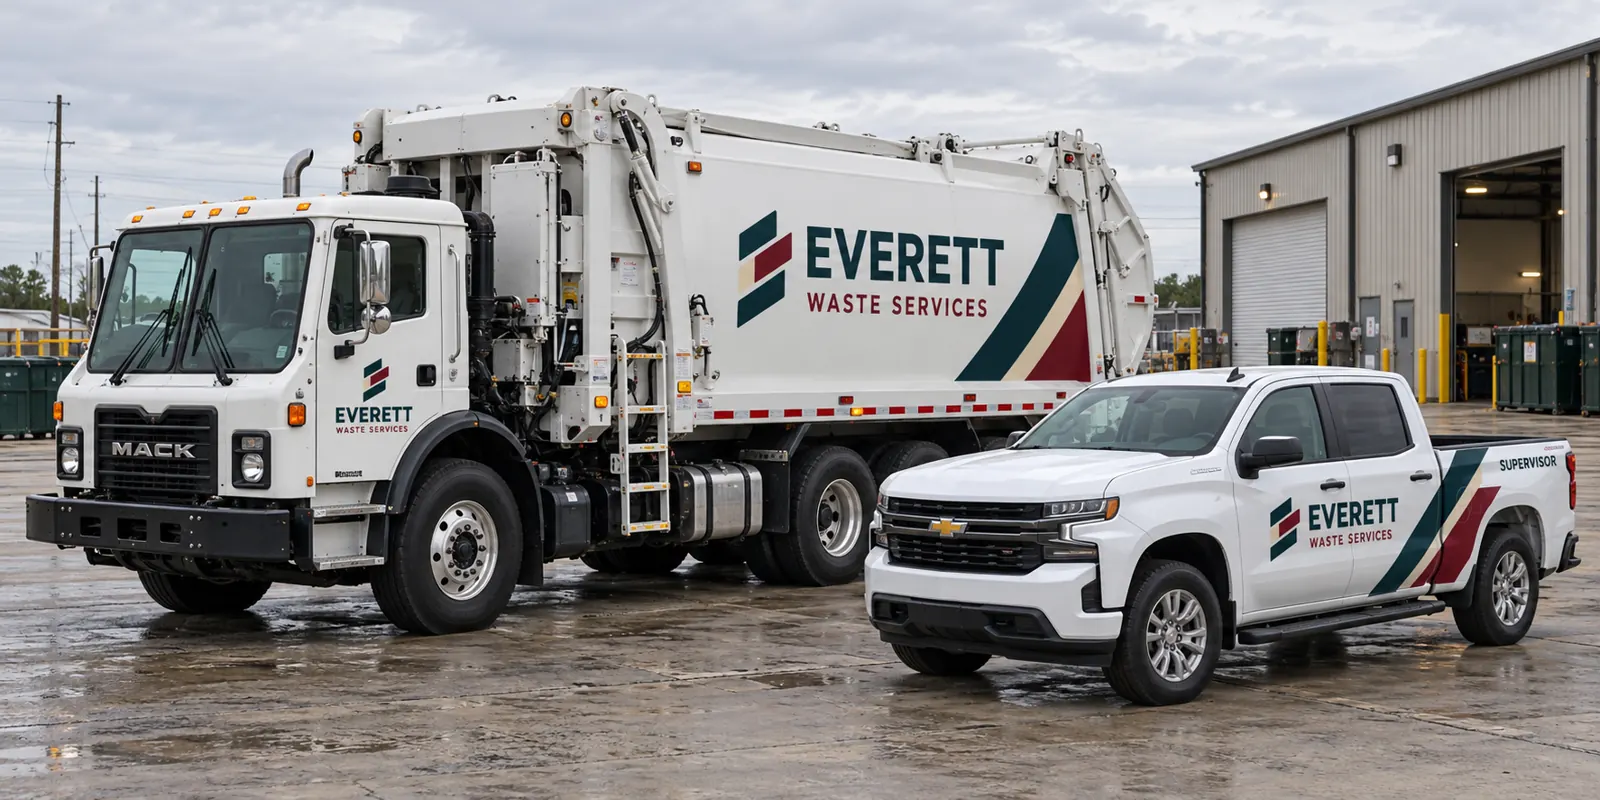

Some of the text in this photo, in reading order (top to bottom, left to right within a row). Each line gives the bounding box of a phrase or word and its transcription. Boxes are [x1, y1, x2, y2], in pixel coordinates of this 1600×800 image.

[806, 225, 1005, 287] EVERETT
[807, 292, 988, 318] WASTE SERVICES
[335, 406, 413, 423] EVERETT
[336, 425, 409, 434] WASTE SERVICES
[112, 442, 196, 458] MACK
[1500, 455, 1557, 471] SUPERVISOR
[1308, 497, 1399, 531] EVERETT
[1309, 529, 1393, 548] WASTE SERVICES
